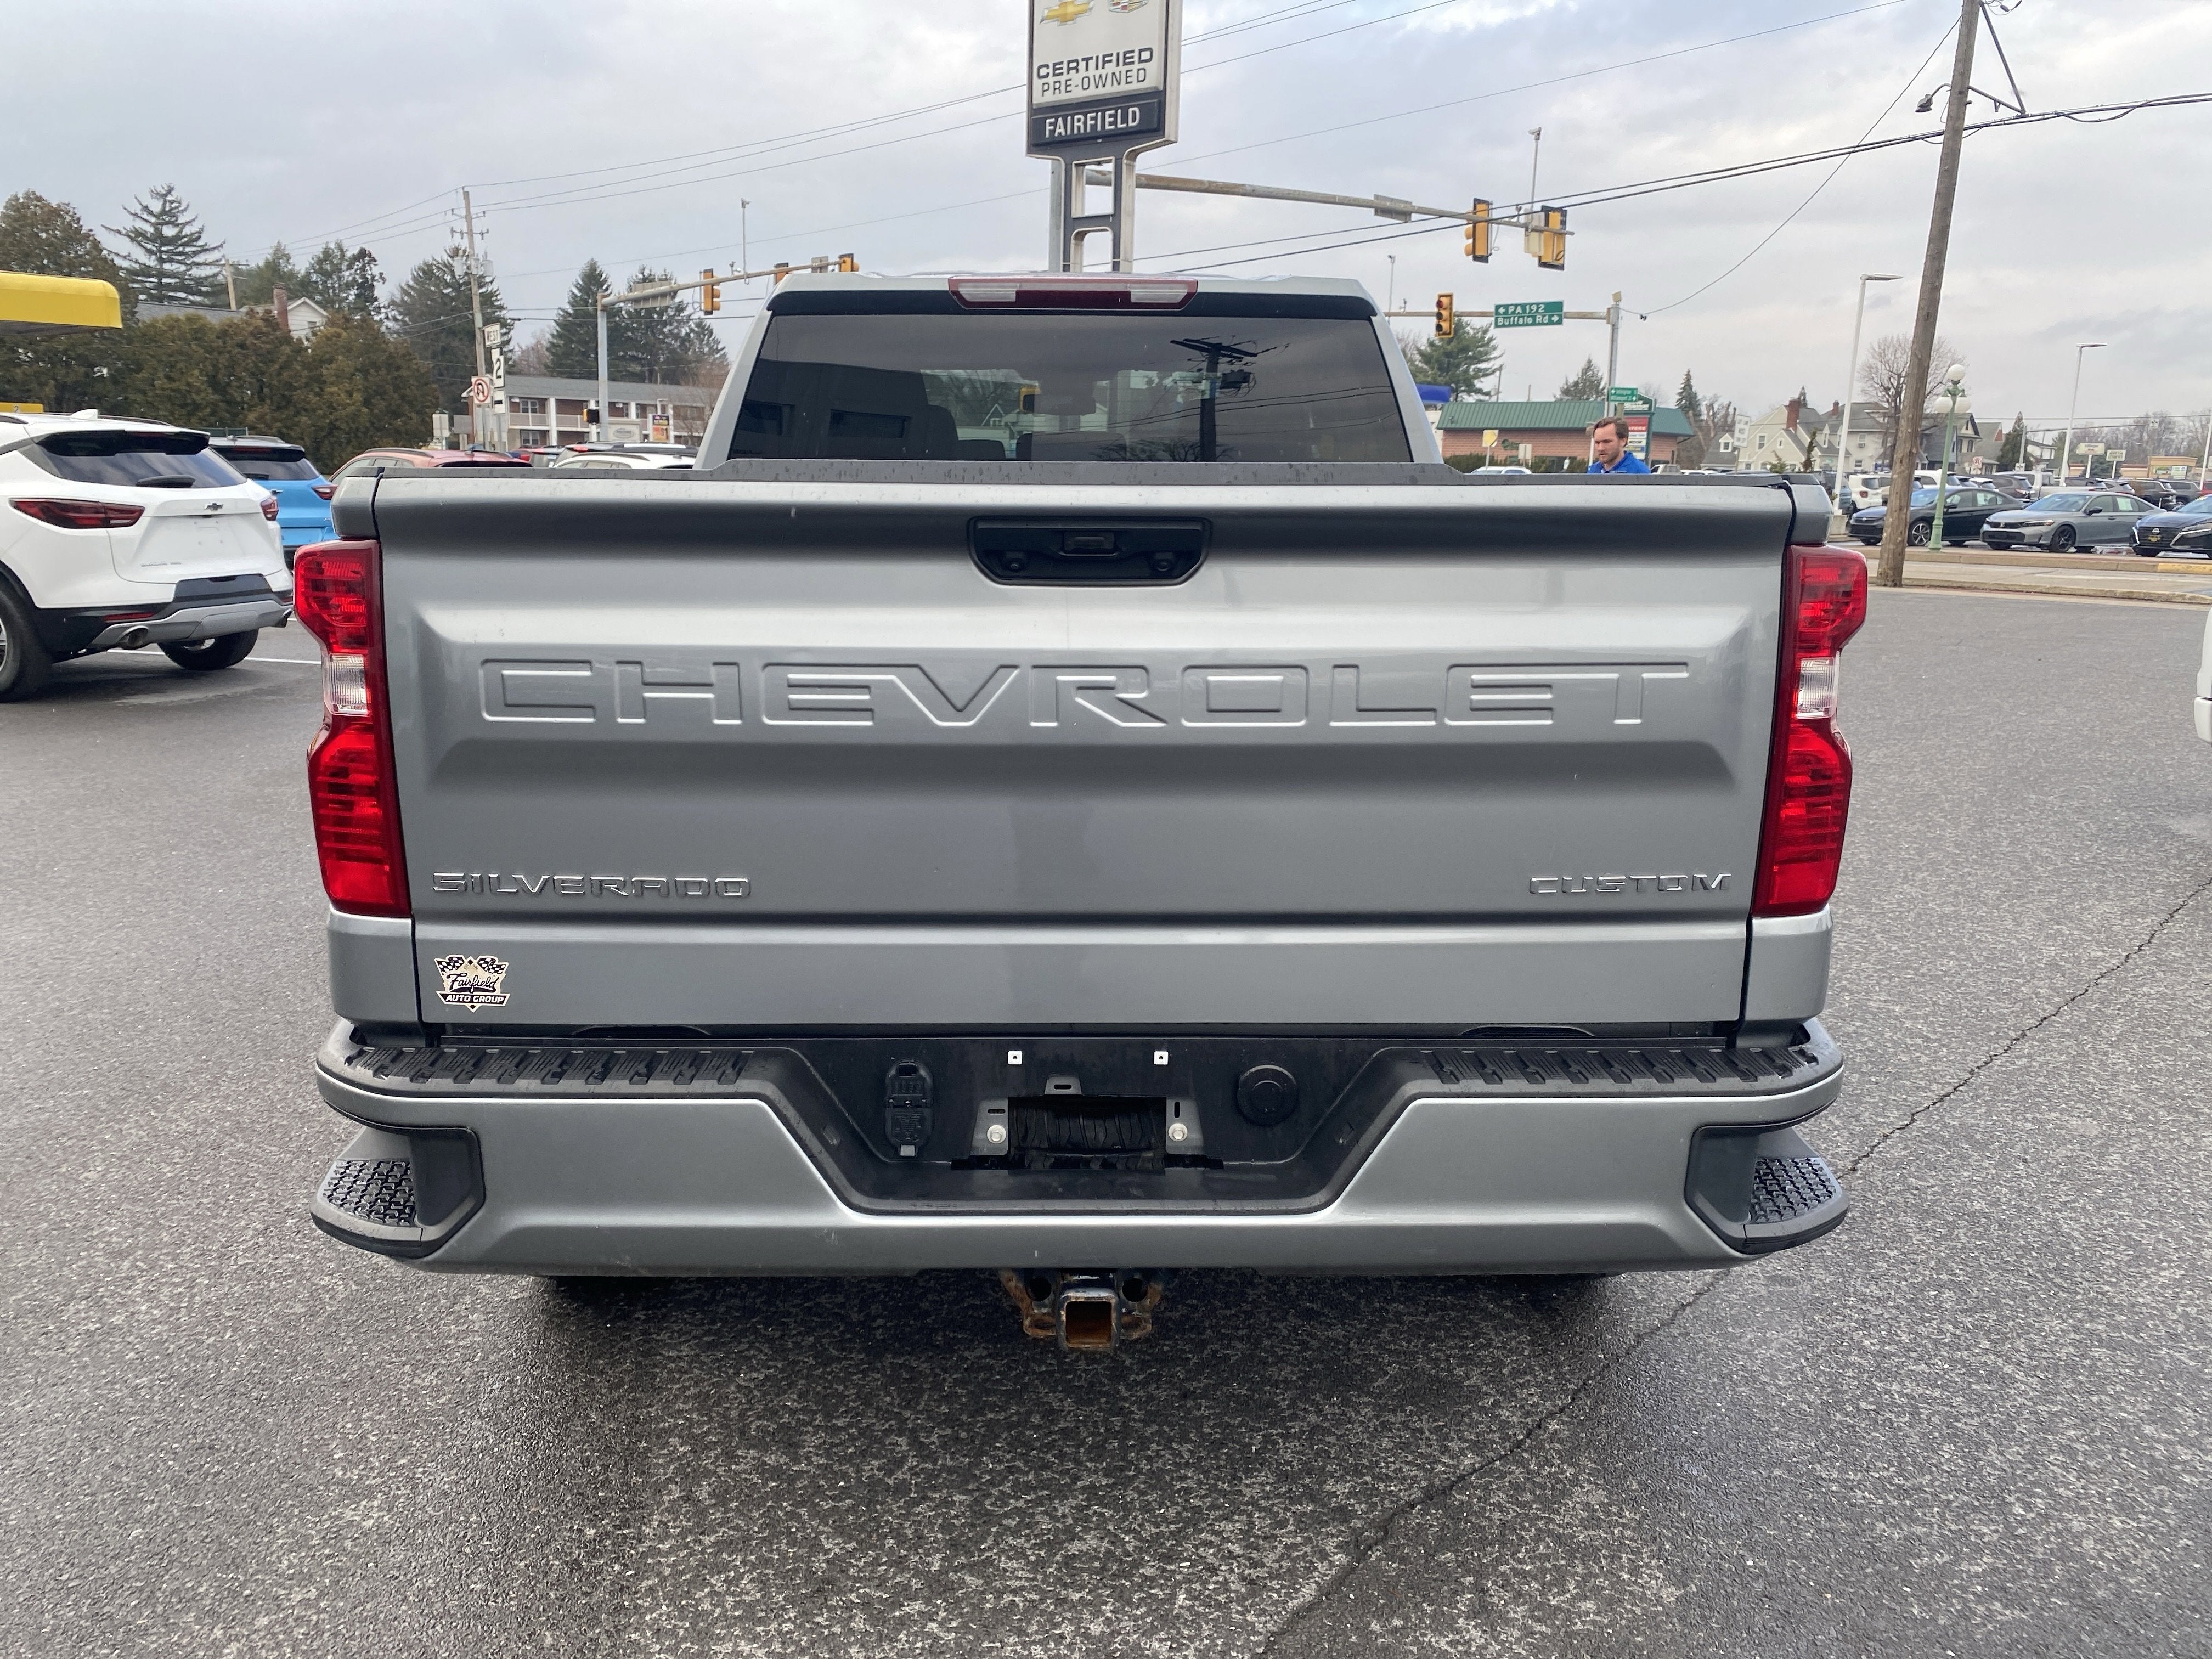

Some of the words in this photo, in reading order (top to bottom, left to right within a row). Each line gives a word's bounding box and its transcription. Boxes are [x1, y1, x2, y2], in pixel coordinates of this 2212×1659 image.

[1037, 47, 1153, 80] CERTIFIED
[1042, 67, 1147, 97] PRE-OWNED
[1045, 107, 1141, 138] FAIRFIELD
[1497, 316, 1533, 325] Buffalo
[1536, 315, 1549, 324] Rd
[1508, 305, 1522, 314] PA
[1526, 304, 1545, 313] 192
[487, 330, 499, 343] WEST
[481, 659, 1690, 727] CHEVROLET
[433, 872, 751, 897] SILVERADO
[1530, 873, 1732, 894] CUSTOM
[446, 972, 500, 994] Fairfield
[445, 994, 471, 1002] AUTO
[472, 995, 504, 1003] GROUP
